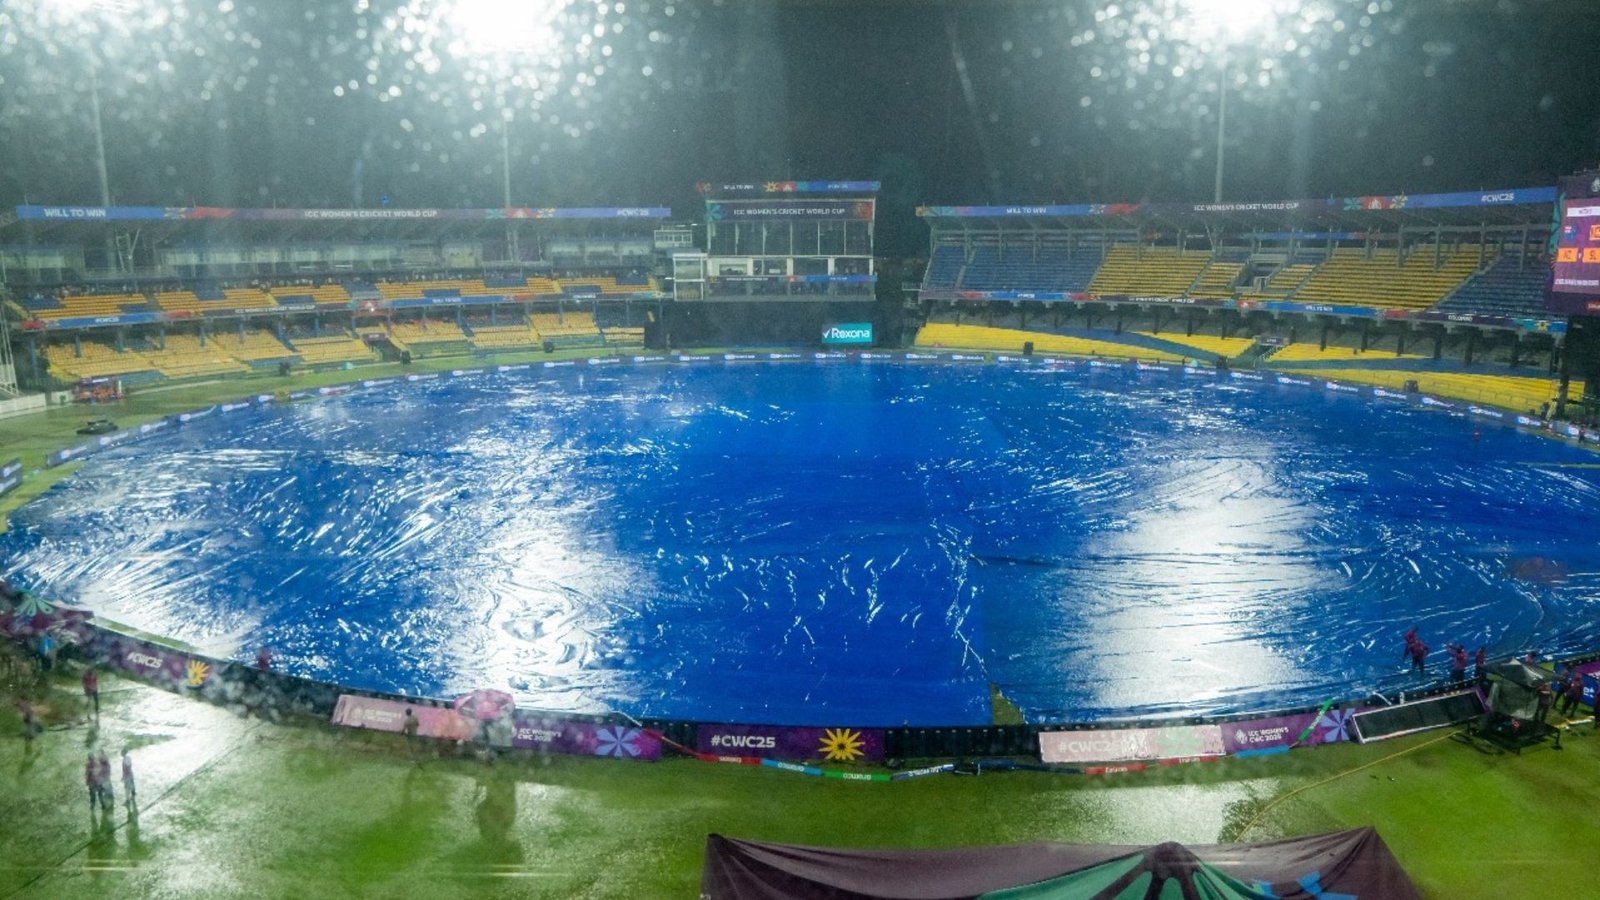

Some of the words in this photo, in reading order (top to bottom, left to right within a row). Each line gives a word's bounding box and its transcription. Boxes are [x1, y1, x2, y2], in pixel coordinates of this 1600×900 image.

[43, 208, 69, 217] WILL
[70, 208, 84, 217] TO
[86, 208, 106, 217] WIN
[831, 327, 870, 339] Rexona
[711, 734, 776, 748] #CWC25
